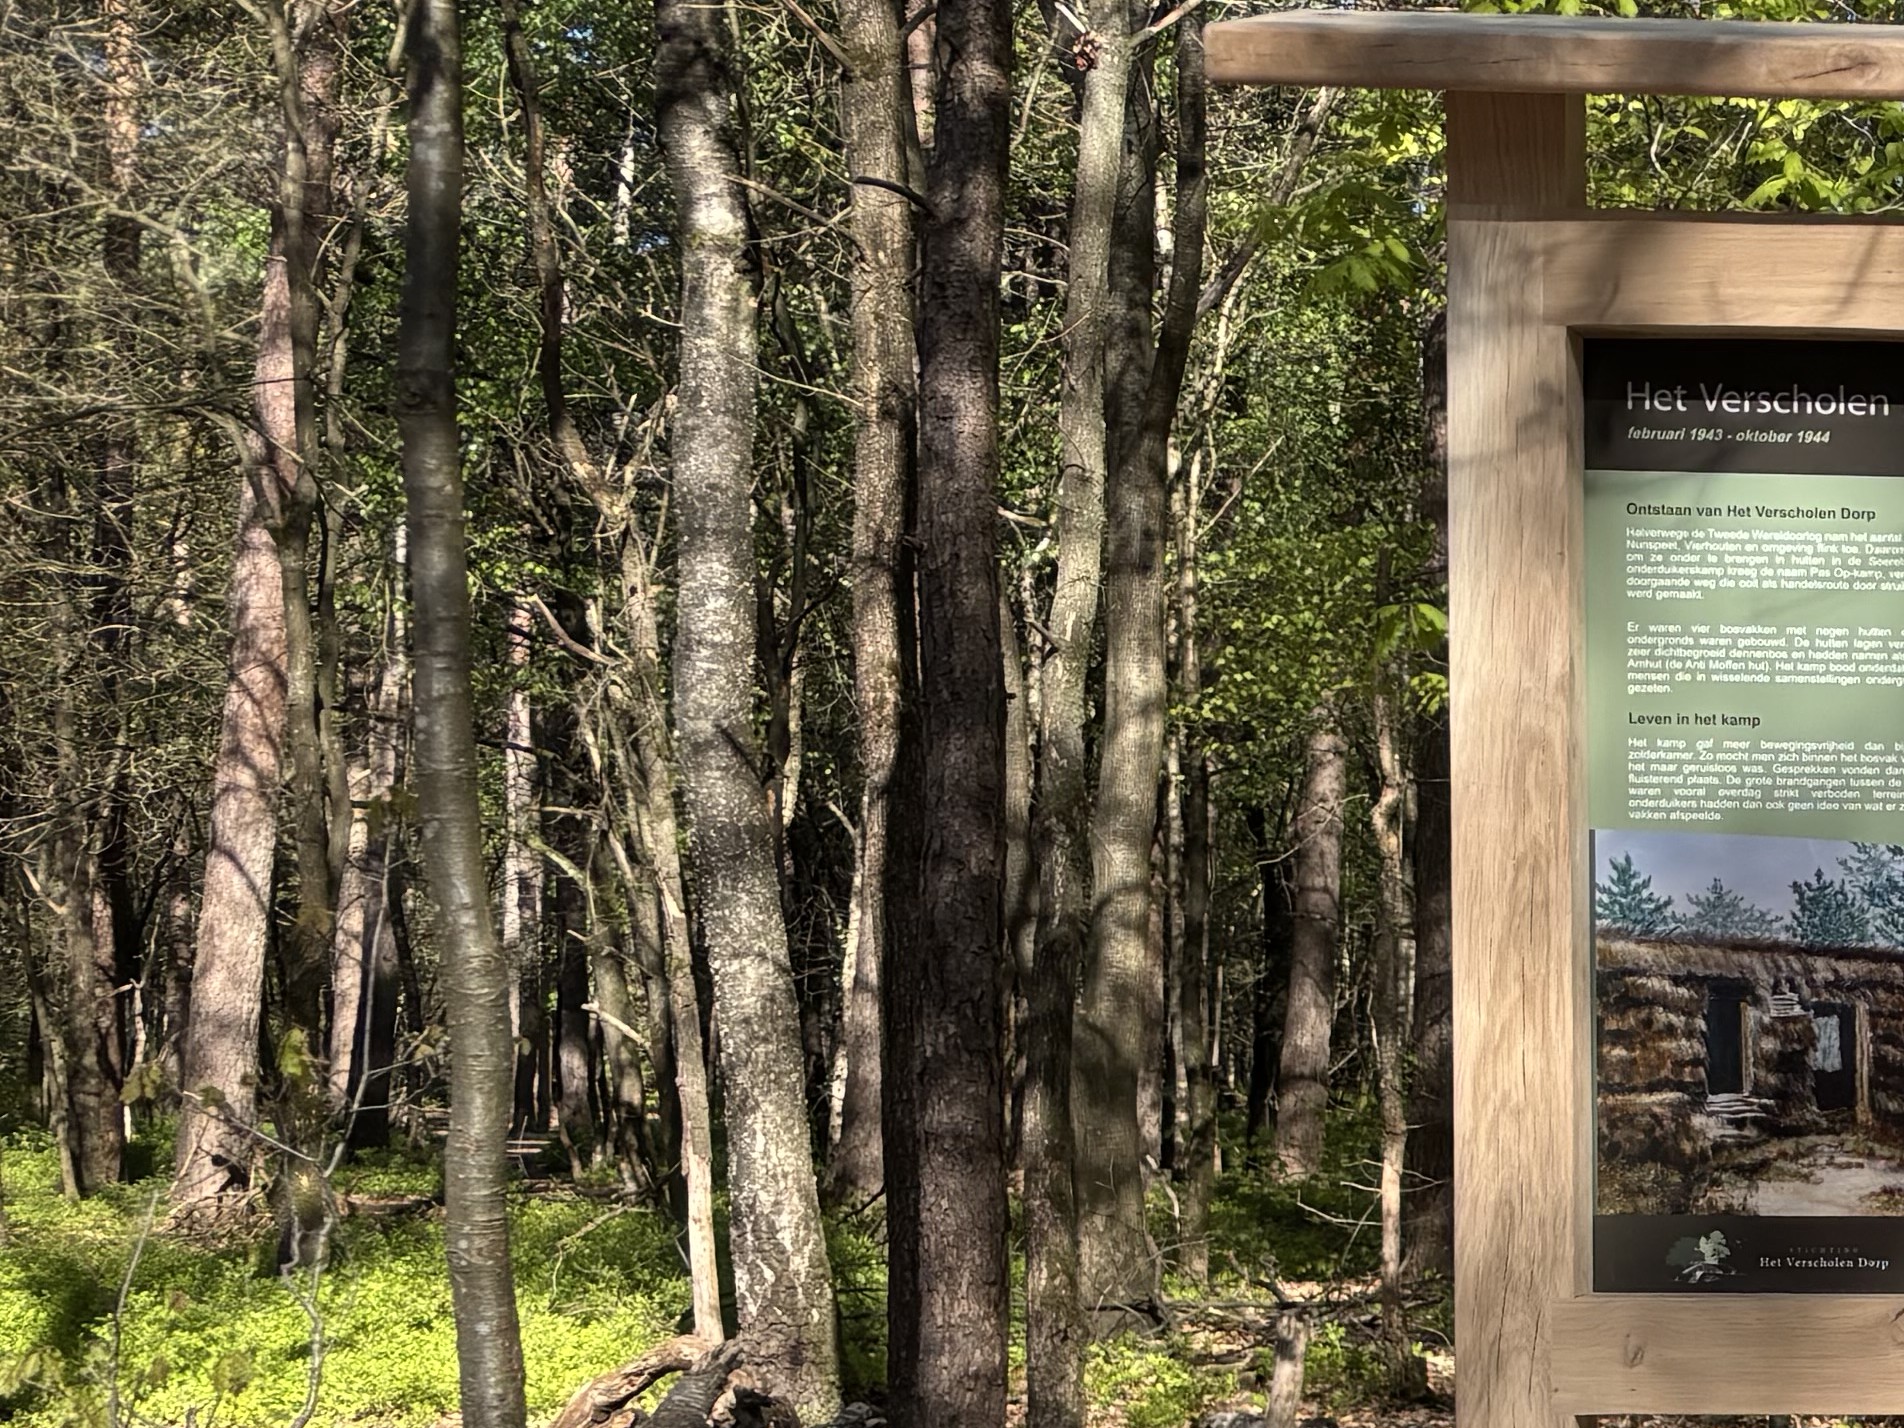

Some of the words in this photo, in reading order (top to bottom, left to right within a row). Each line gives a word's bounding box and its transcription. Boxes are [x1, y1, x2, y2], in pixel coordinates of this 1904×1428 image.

[1628, 382, 1687, 412] Het
[1700, 382, 1889, 416] Verscholen
[1628, 426, 1686, 440] februari
[1690, 428, 1724, 441] 1943
[1736, 429, 1794, 442] oktober
[1798, 430, 1830, 444] 1944
[1626, 502, 1692, 516] Ontstaan
[1697, 506, 1722, 517] van
[1726, 504, 1752, 518] Het
[1754, 505, 1836, 519] Verscholen
[1840, 508, 1876, 523] Dorp
[1628, 712, 1672, 726] Leven
[1676, 712, 1690, 725] in
[1694, 713, 1716, 726] het
[1722, 713, 1760, 729] kamp
[1760, 1257, 1780, 1267] Het
[1786, 1257, 1854, 1268] Verscholen
[1858, 1256, 1888, 1269] Dorp
